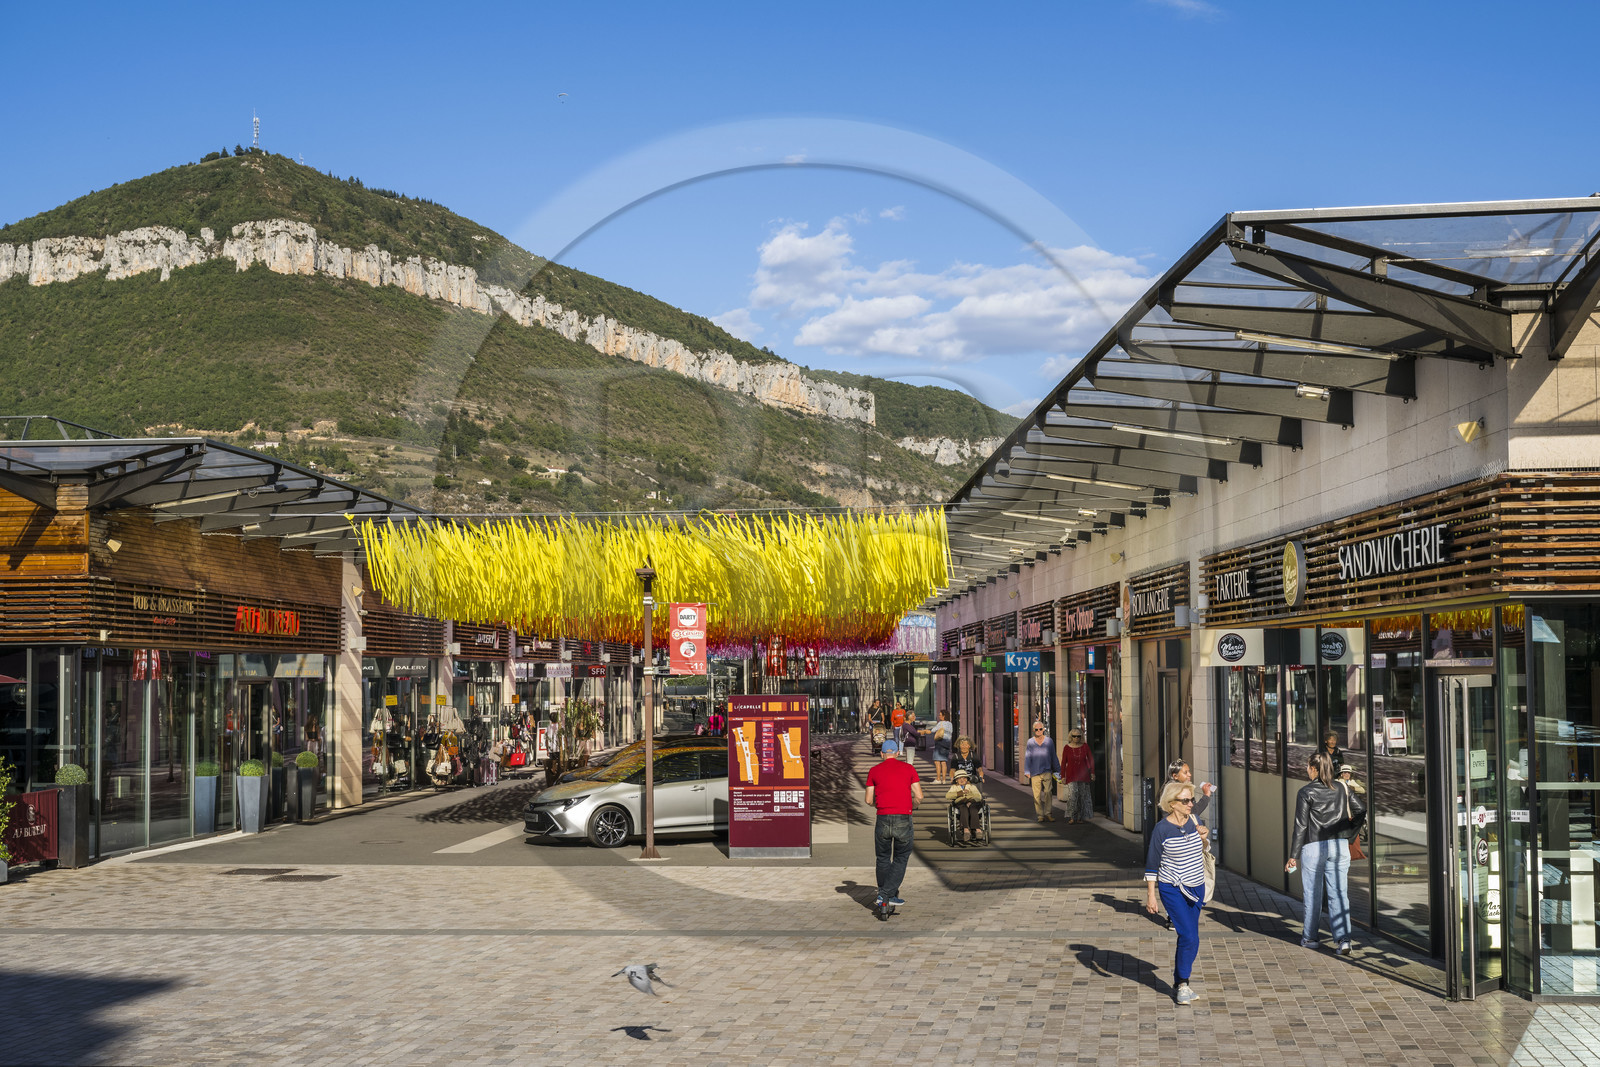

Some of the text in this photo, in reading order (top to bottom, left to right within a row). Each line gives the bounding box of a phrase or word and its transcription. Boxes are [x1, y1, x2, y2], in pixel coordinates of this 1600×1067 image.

[1338, 523, 1447, 581] SANDWICHERIE
[1215, 569, 1250, 601] TARTERIE
[133, 595, 149, 611] PUB
[158, 598, 194, 615] BRASSERIE
[1133, 588, 1170, 616] BOULANGERIE
[239, 607, 301, 637] AU BUREAU
[591, 667, 606, 675] SFR
[1006, 653, 1039, 670] Krys
